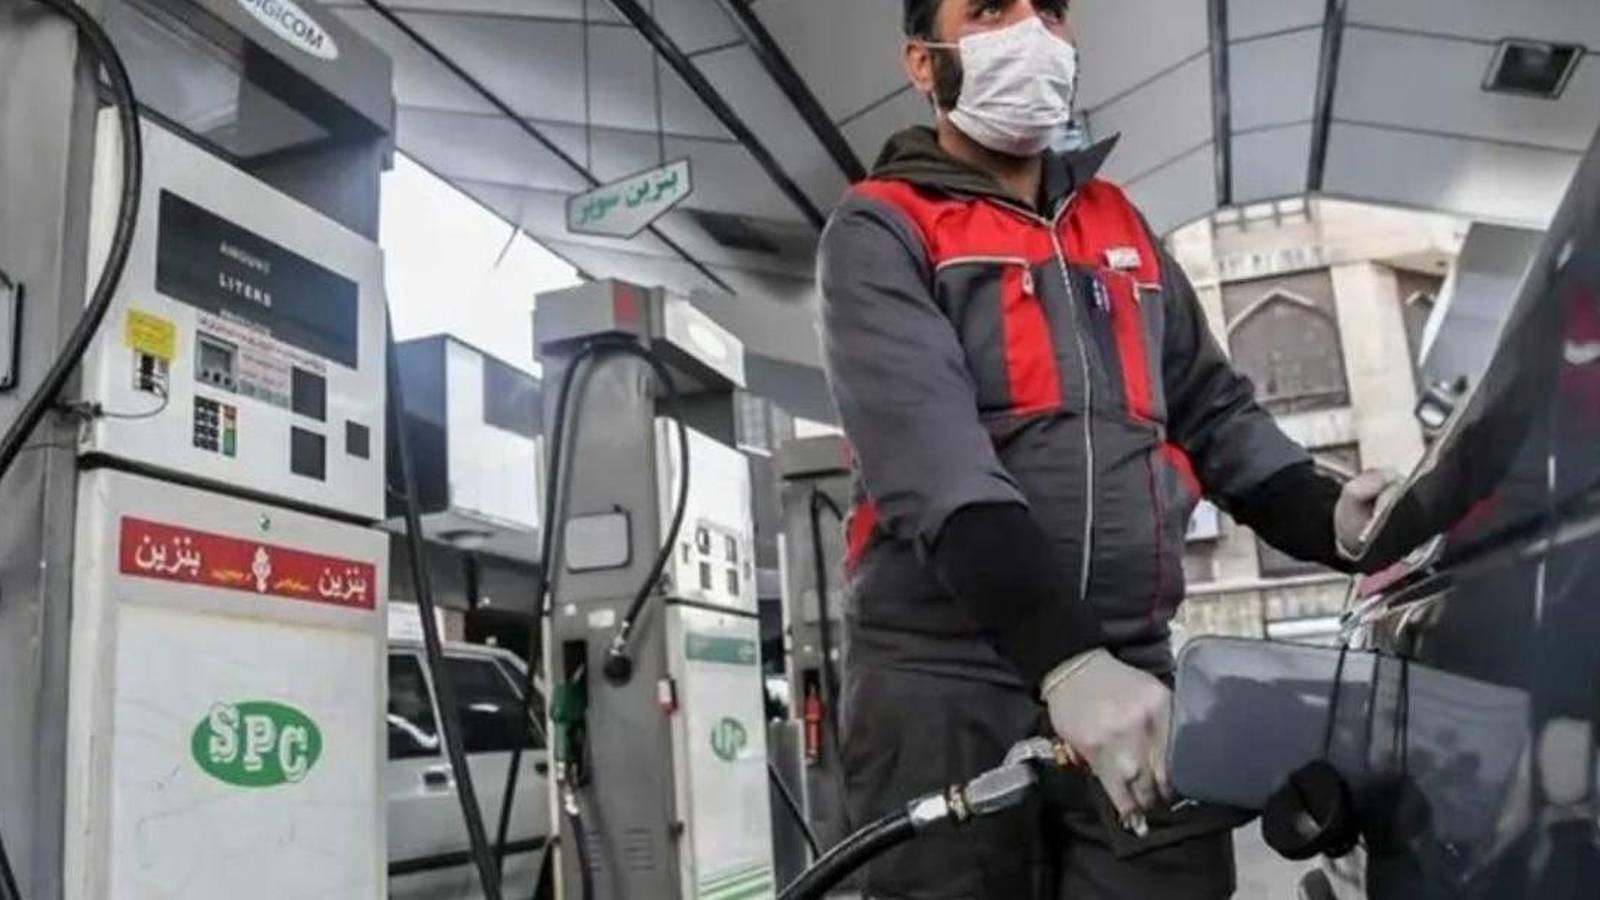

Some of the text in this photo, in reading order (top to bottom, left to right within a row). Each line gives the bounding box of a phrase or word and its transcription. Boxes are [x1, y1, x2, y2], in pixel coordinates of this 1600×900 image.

[245, 0, 323, 50] GICOM
[134, 534, 201, 576] بنزین
[318, 566, 367, 601] بنزین
[208, 702, 308, 783] SPC
